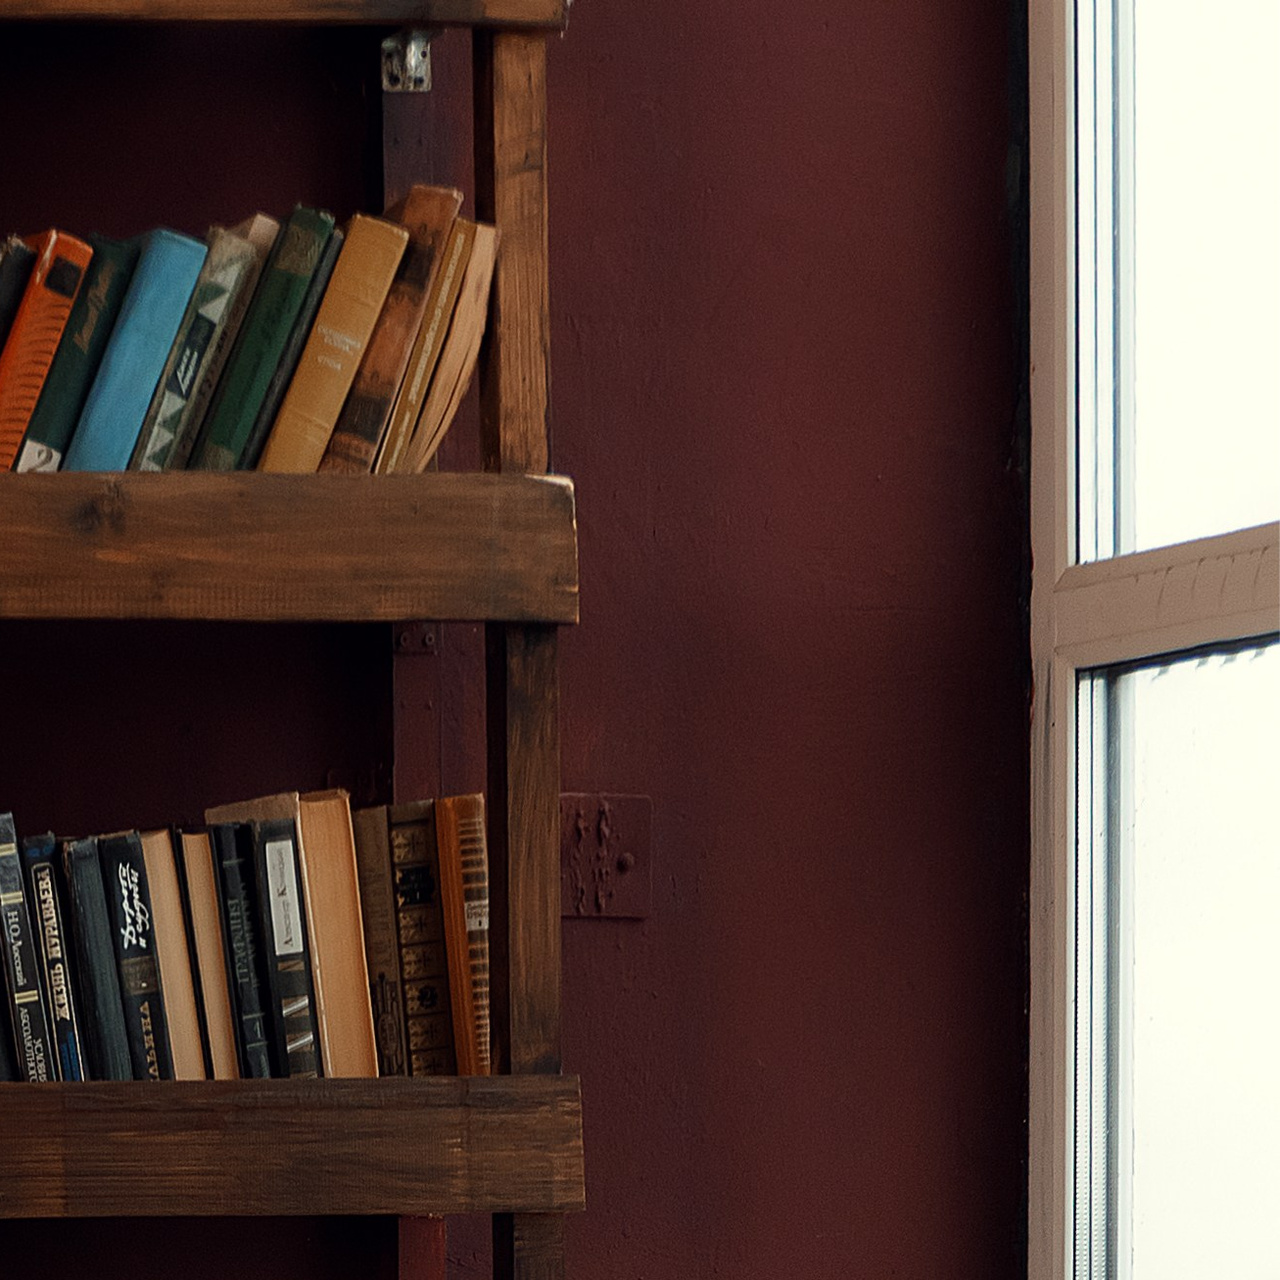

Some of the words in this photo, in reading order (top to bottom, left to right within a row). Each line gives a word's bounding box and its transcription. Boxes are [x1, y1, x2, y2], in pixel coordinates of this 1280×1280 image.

[39, 868, 62, 957] МУРАВЬЕВА
[117, 862, 141, 950] Дороги
[128, 868, 152, 935] судьбы
[227, 897, 251, 985] ГРАФИНЯ
[54, 955, 71, 1021] ЖИЗНЬ
[138, 1000, 160, 1082] ЛЬИНА
